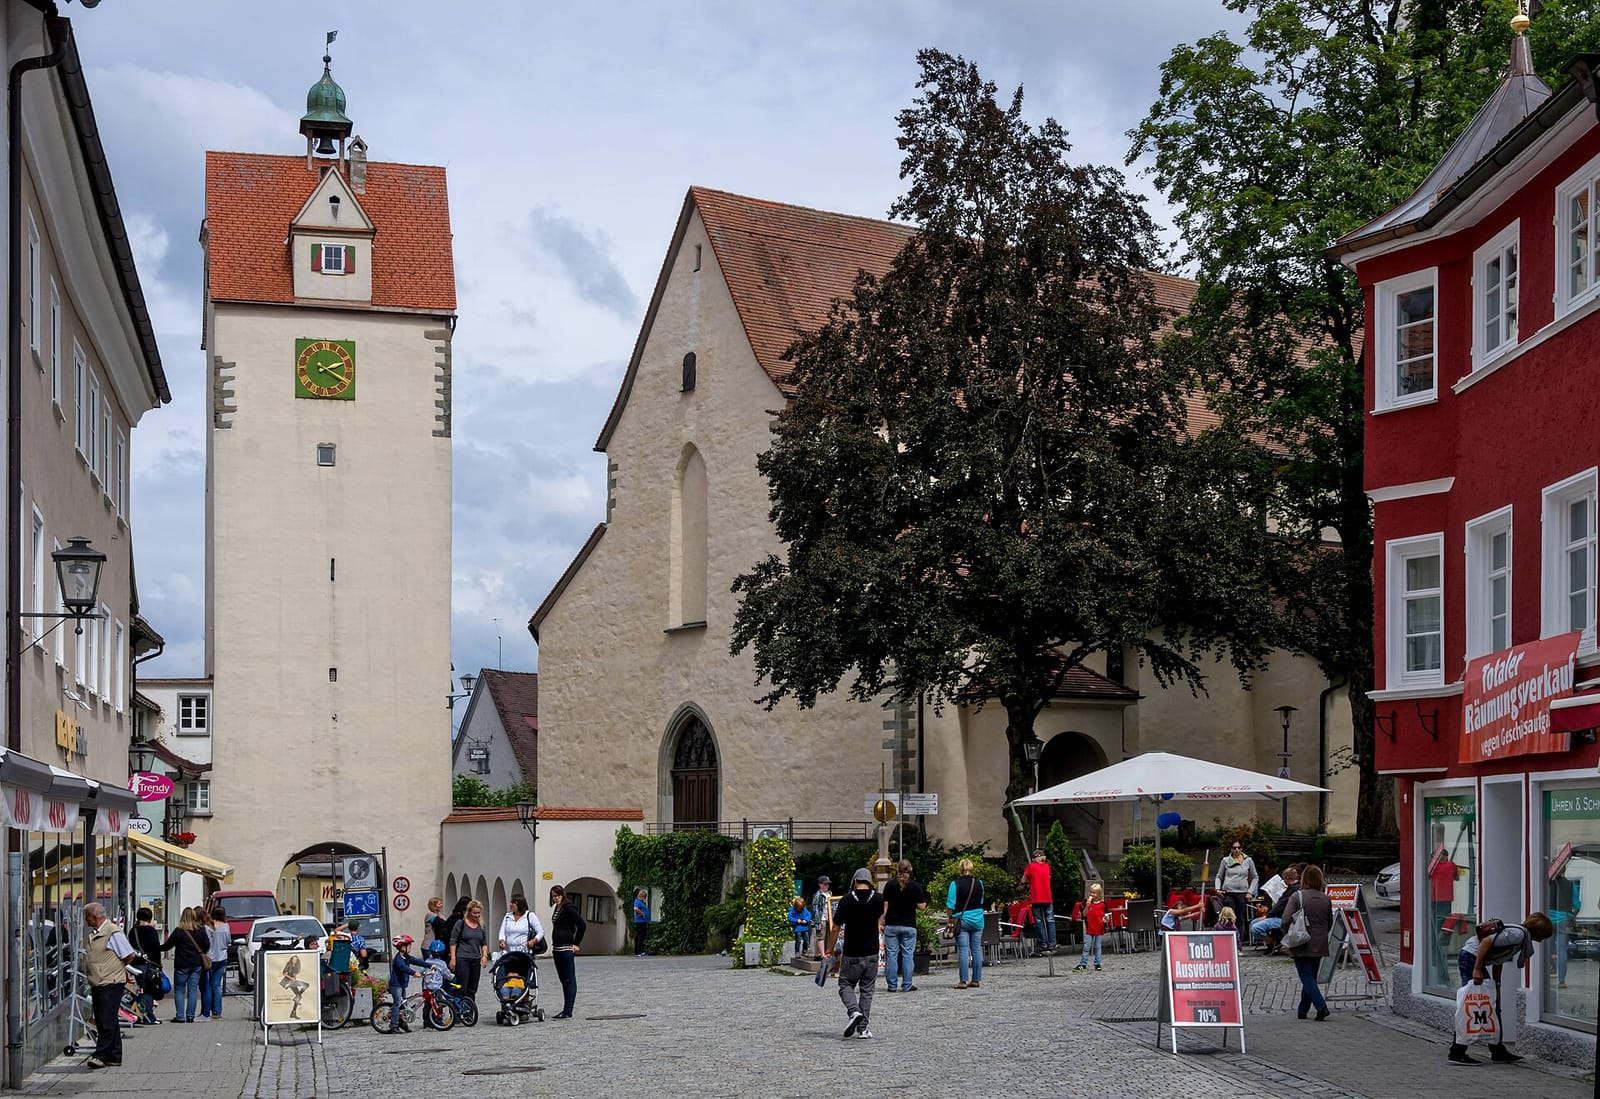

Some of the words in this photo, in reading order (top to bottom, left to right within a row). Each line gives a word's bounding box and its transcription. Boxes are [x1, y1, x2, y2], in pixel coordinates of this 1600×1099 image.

[1482, 649, 1525, 693] Totaler
[1465, 652, 1575, 735] Räumungsverkauf
[139, 783, 170, 794] Trendy
[14, 788, 31, 825] NKD
[48, 800, 67, 829] NKD
[1189, 942, 1214, 959] Total
[1176, 961, 1231, 978] Ausverkauf
[1197, 1008, 1217, 1023] 70%
[1473, 1010, 1488, 1025] M
